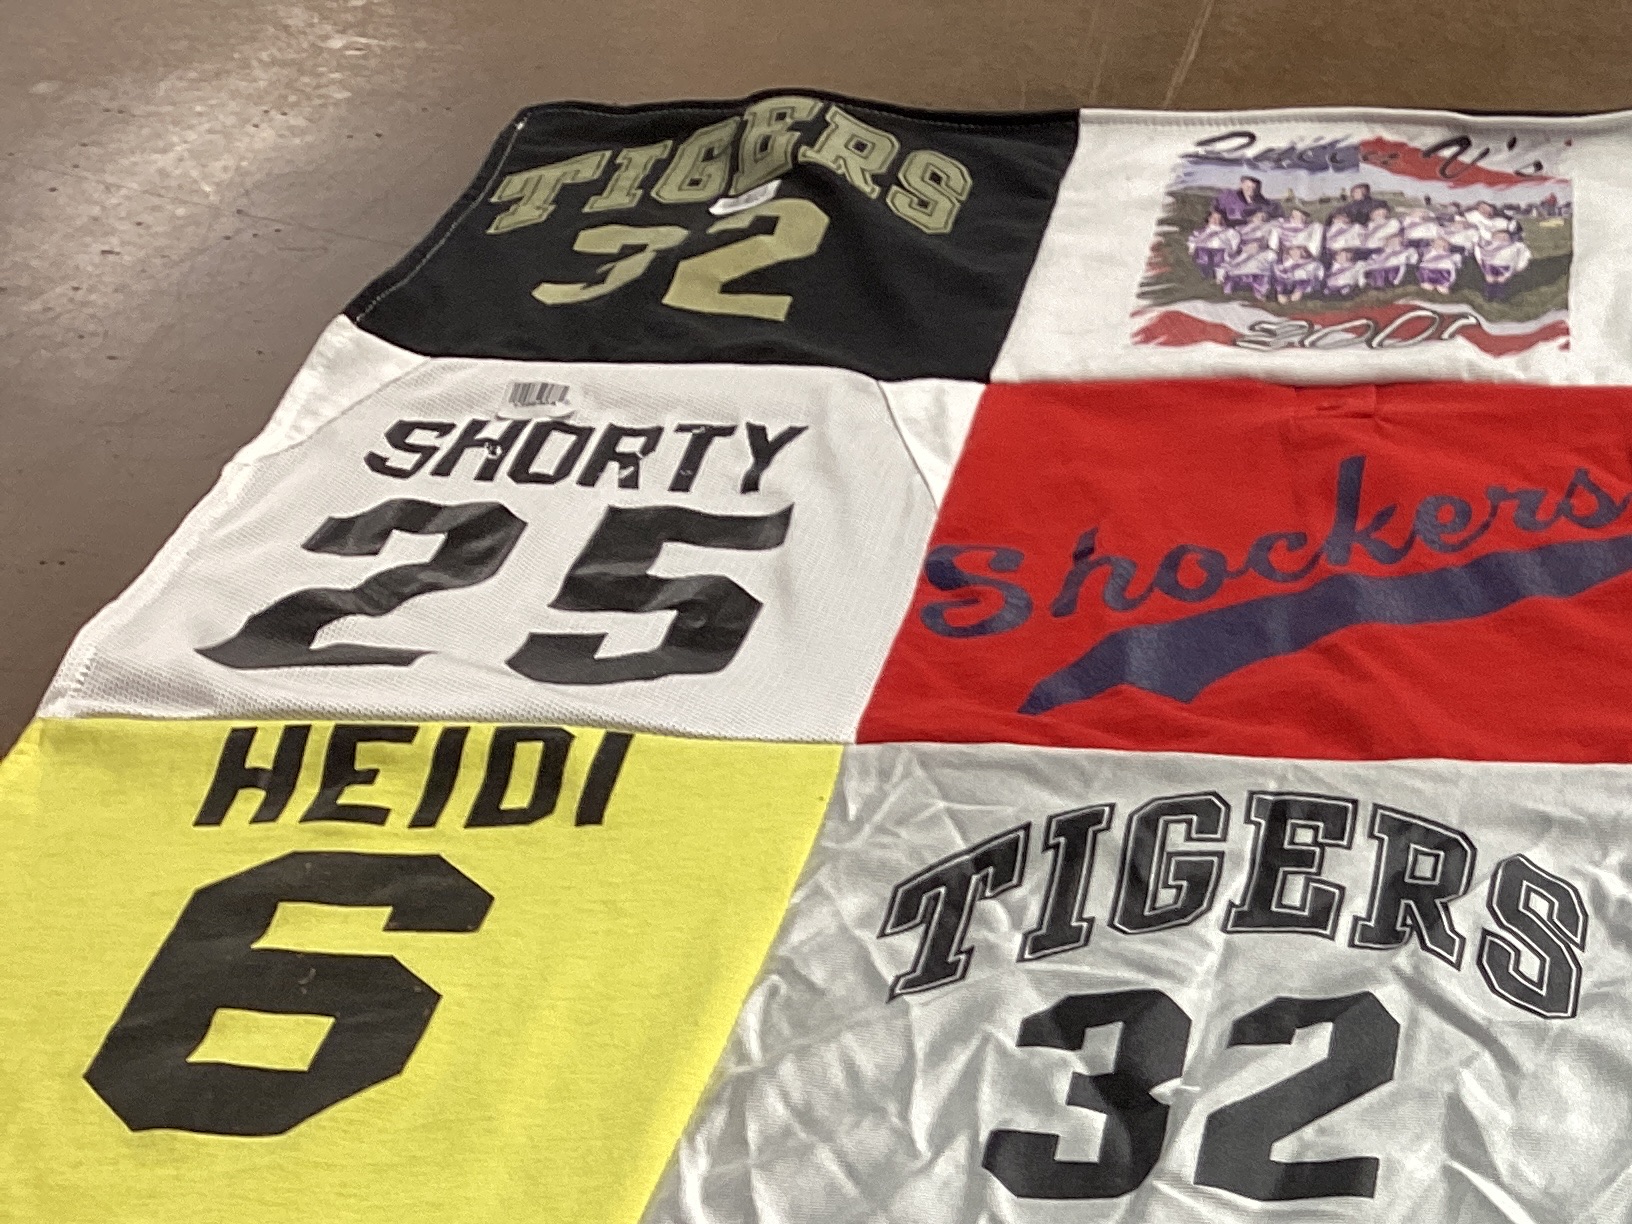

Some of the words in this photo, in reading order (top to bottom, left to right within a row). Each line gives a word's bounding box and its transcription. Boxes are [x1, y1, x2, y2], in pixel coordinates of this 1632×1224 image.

[487, 96, 973, 235] TIGERS
[532, 199, 830, 322] 32
[364, 418, 808, 494] SHORTY
[193, 498, 795, 685] 25
[193, 724, 635, 829] HEIDI
[877, 789, 1587, 1020] TIGERS
[83, 850, 495, 1138] 6
[982, 988, 1400, 1201] 32
